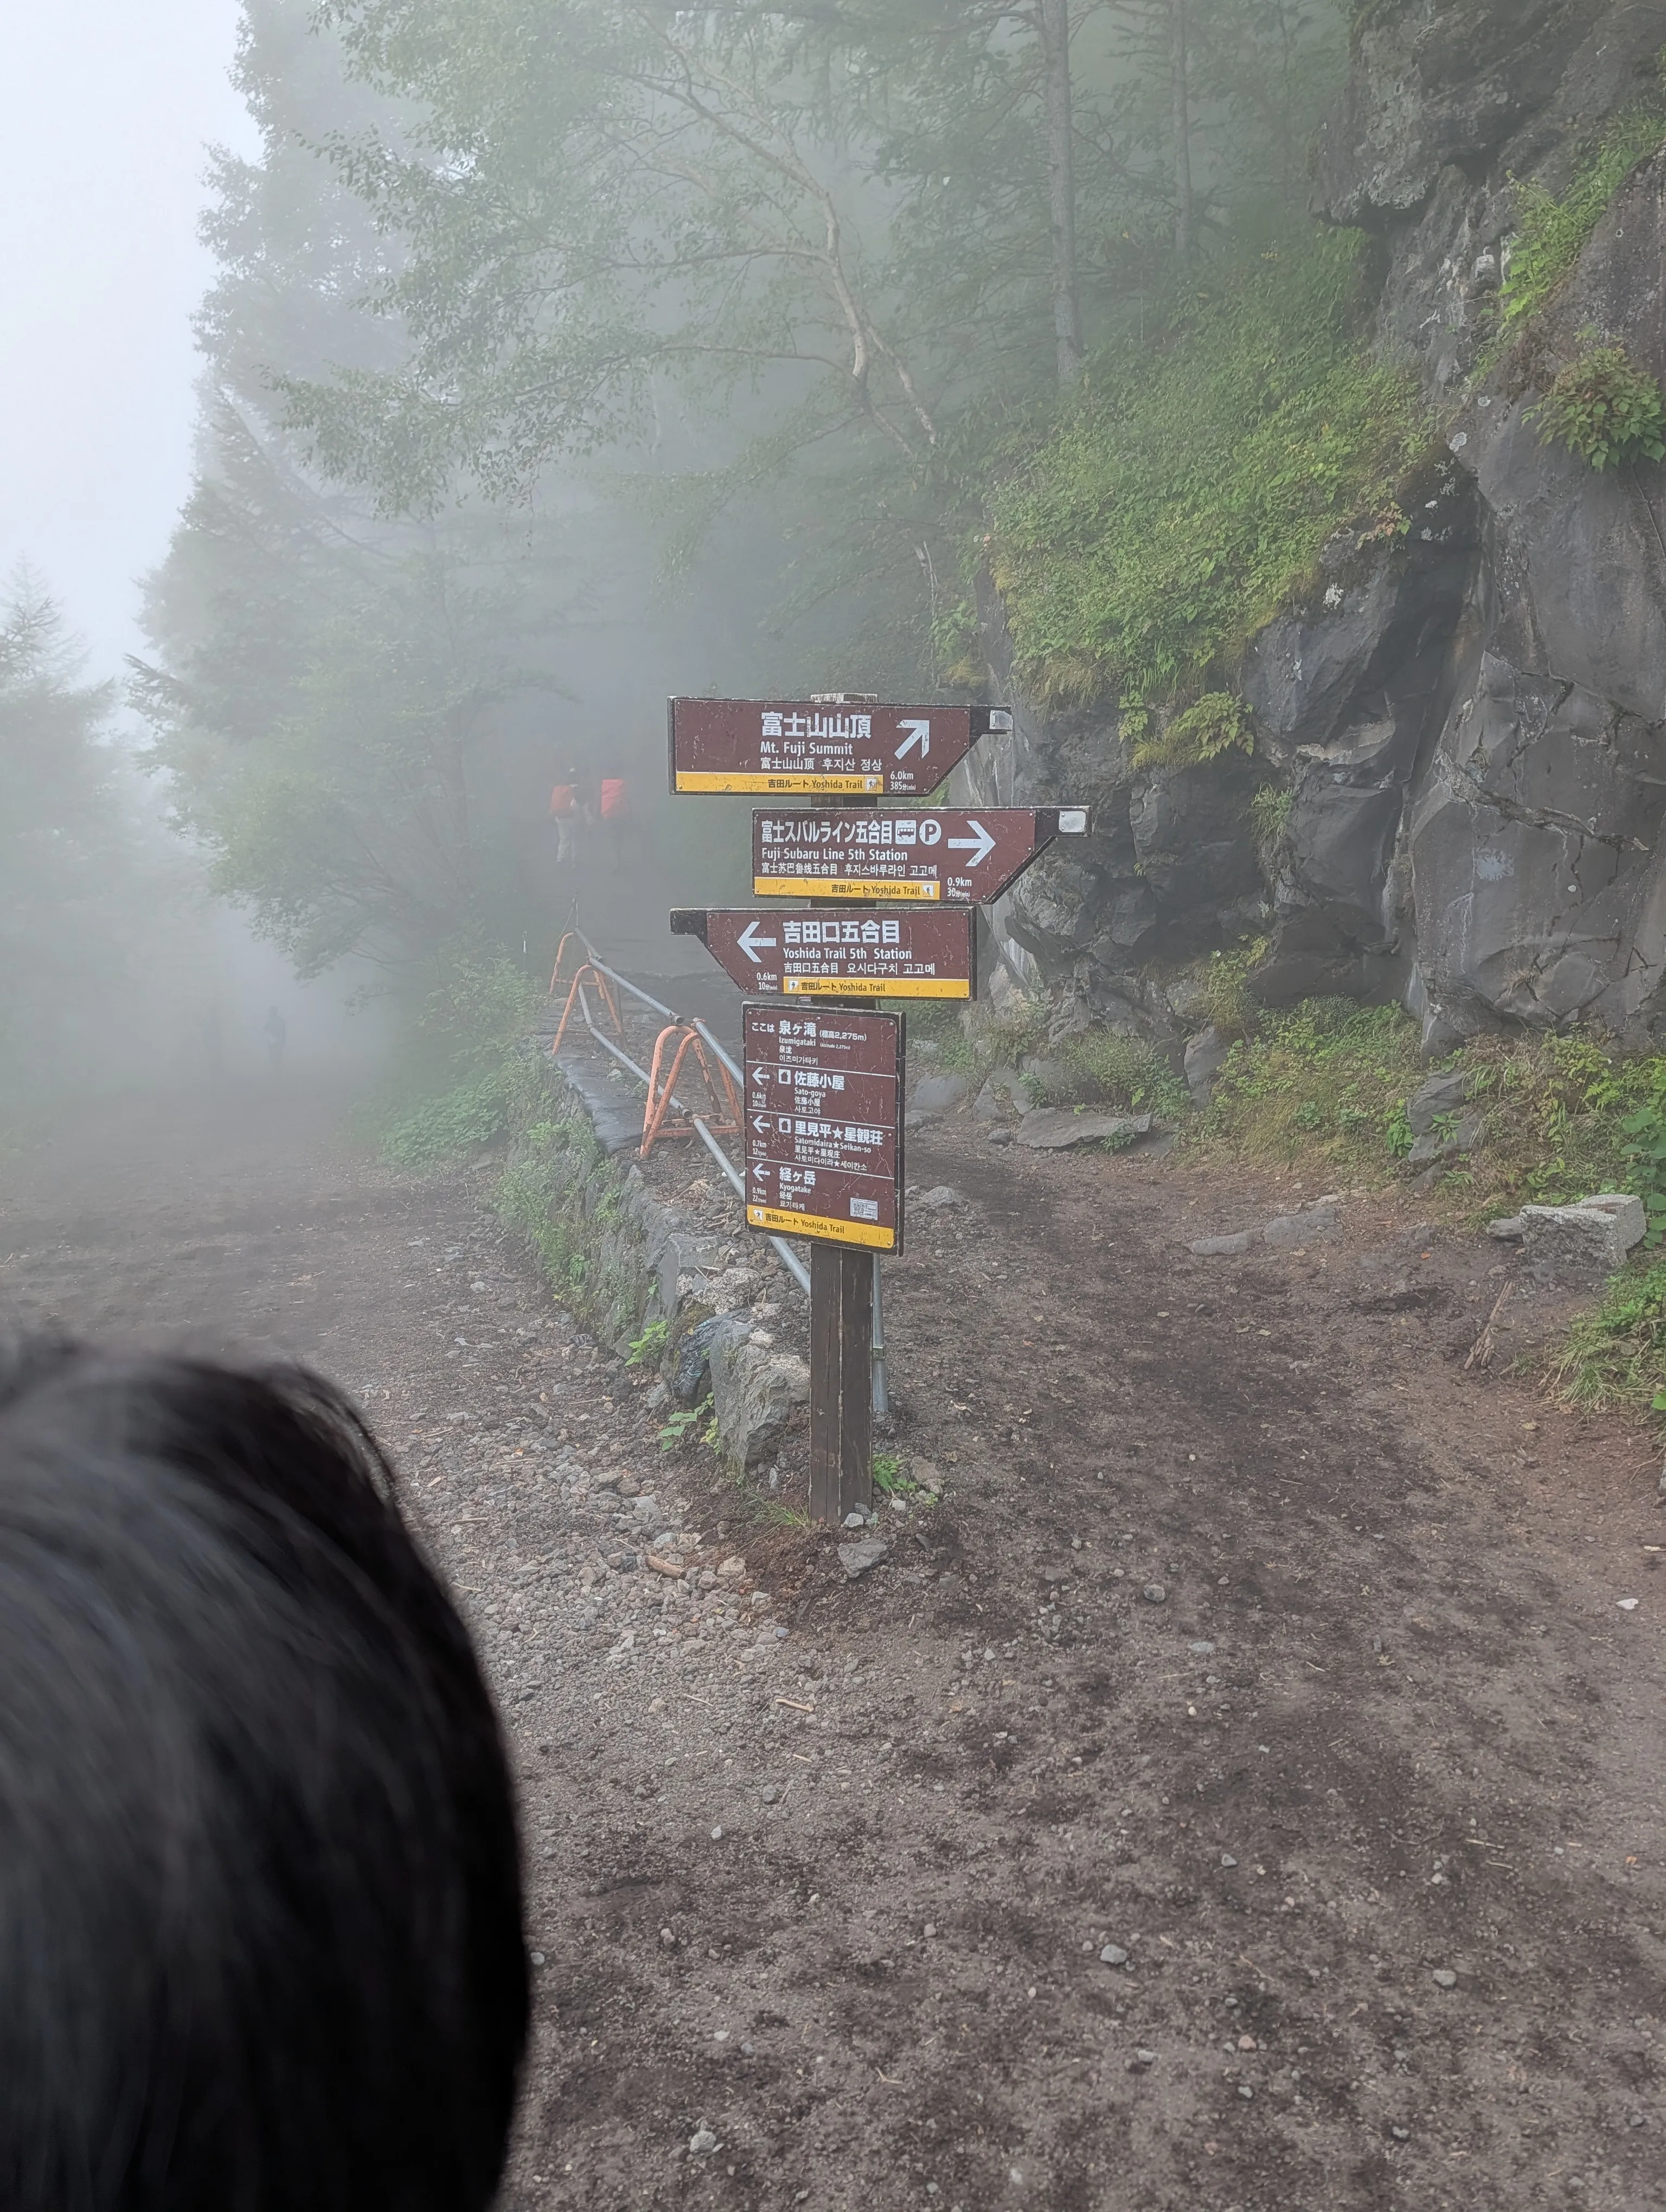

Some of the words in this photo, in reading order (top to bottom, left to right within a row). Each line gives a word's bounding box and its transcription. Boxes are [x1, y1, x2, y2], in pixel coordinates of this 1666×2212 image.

[761, 711, 872, 739] 富士山山頂
[760, 741, 779, 754] Mt.
[784, 742, 805, 756] Fuji
[809, 742, 853, 755] Summit
[760, 757, 815, 770] 富士山山顶
[822, 757, 856, 771] 후지산
[861, 758, 882, 771] 정상
[890, 770, 914, 780] 6.0km
[768, 779, 809, 789] 吉田ルート
[812, 780, 842, 789] Yoshida
[845, 780, 863, 789] Trail
[761, 820, 892, 845] 富士スバルライン五合目
[762, 848, 780, 862] Fuji
[784, 848, 819, 860] Subaru
[823, 848, 844, 860] Line
[848, 848, 866, 860] 5th
[869, 849, 907, 861] Station
[844, 863, 905, 877] 후지스바루라인
[909, 865, 938, 878] 고고메
[947, 877, 972, 886] 0.9km
[831, 884, 868, 894] 吉田ルート
[872, 885, 901, 895] Yoshida
[903, 886, 920, 895] Trail
[783, 920, 899, 944] 吉田口五合目
[783, 948, 821, 960] Yoshida
[824, 948, 847, 959] Trail
[850, 948, 867, 960] 5th
[874, 948, 912, 960] Station
[784, 962, 838, 974] 吉田口五合目
[847, 963, 898, 975] 요시다구치
[903, 963, 935, 976] 고고메
[757, 972, 777, 981] 0.6km
[801, 982, 837, 991] 吉田ルート
[839, 982, 868, 992] Yoshida
[869, 983, 885, 992] Trail
[752, 1022, 774, 1033] ここは
[779, 1037, 816, 1046] Izumigataki
[779, 1054, 818, 1066] 이즈미가타키
[794, 1071, 845, 1090] 佐藤小屋
[794, 1087, 826, 1098] Sato-goya
[779, 1182, 811, 1194] Kyogatake
[765, 1213, 799, 1226] 吉田ルート
[801, 1219, 828, 1231] Yoshida
[830, 1224, 845, 1234] Trail
